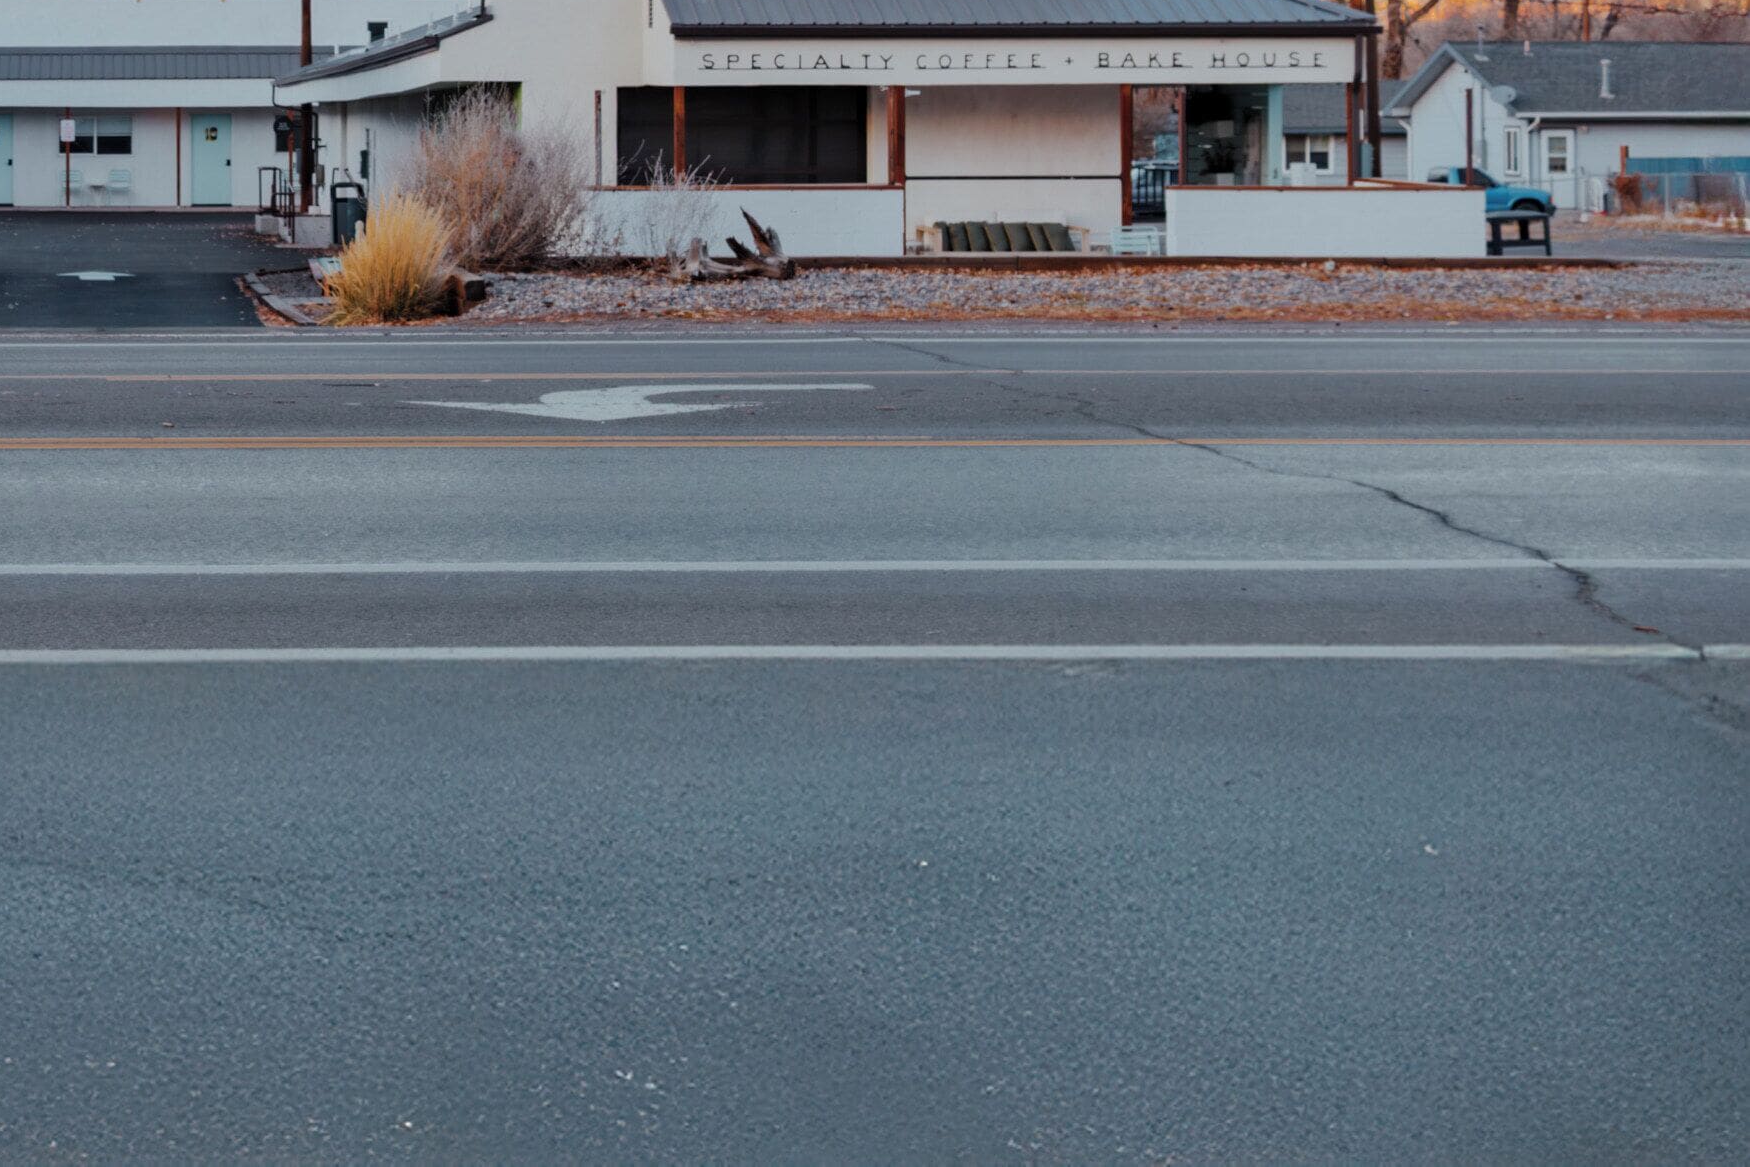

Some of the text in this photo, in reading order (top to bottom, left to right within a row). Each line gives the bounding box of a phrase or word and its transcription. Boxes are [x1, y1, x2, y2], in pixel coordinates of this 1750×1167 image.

[702, 54, 892, 69] SPECIALTY
[916, 54, 1042, 69] COFFEE
[1098, 53, 1183, 68] BAKE
[1211, 52, 1325, 68] HOUSE
